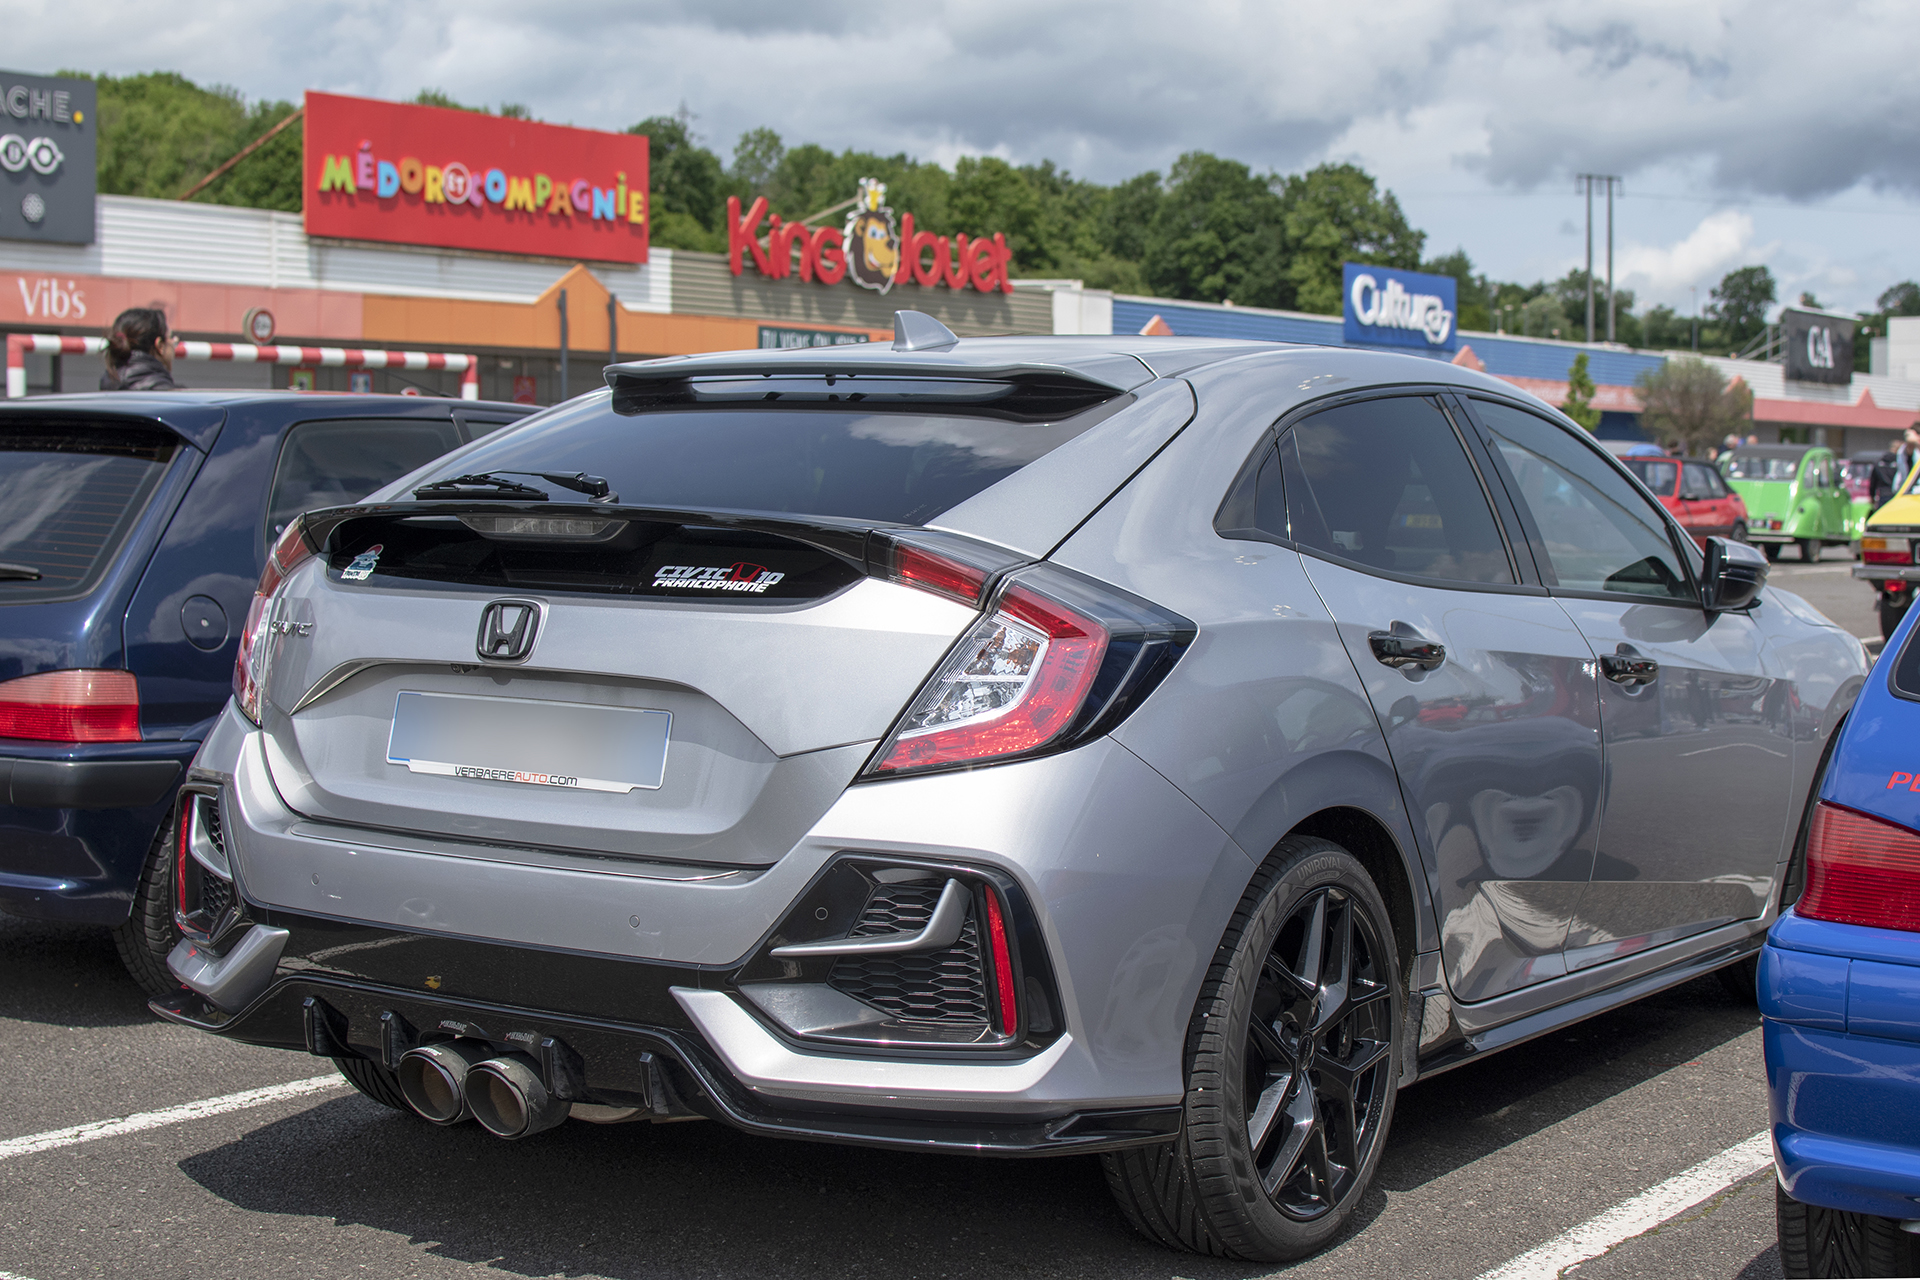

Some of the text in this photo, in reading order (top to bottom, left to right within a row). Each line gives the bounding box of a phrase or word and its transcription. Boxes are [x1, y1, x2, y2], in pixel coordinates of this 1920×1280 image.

[318, 140, 446, 204] MÉDOR
[893, 212, 1014, 294] Jouet
[17, 277, 87, 319] Vib's
[1351, 273, 1453, 344] Cultura
[652, 578, 769, 593] FRANCOPHONE
[655, 565, 785, 585] CIVIC 10
[454, 766, 578, 787] VERBAEREAUTO.COM
[1296, 857, 1344, 881] UNIROYAL
